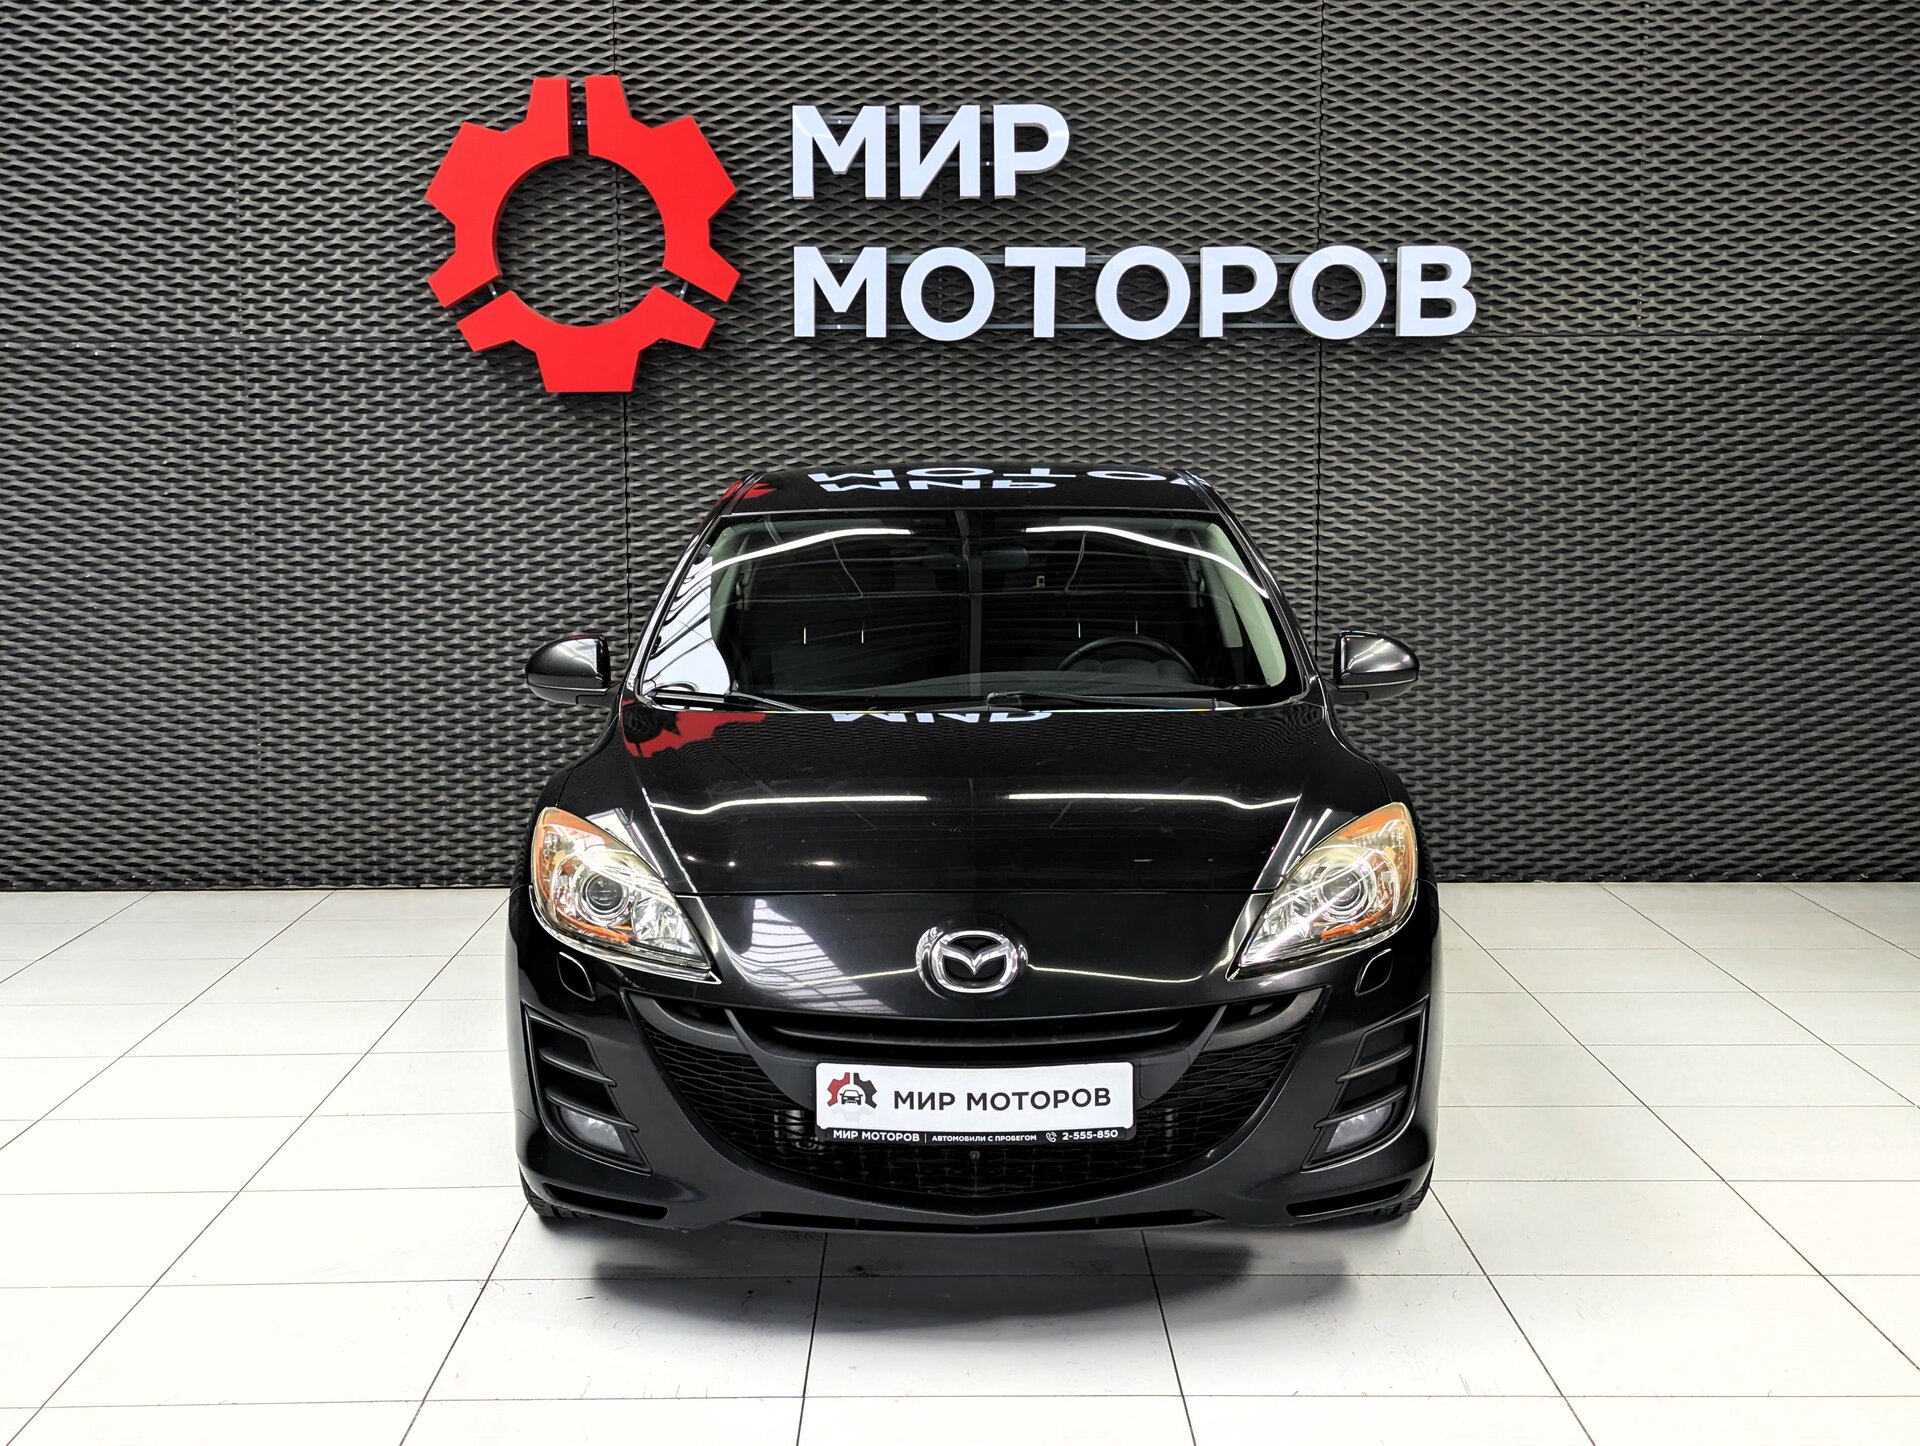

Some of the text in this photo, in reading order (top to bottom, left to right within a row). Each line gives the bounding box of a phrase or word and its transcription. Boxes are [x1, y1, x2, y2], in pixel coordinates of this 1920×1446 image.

[792, 104, 1070, 198] МИР
[793, 245, 1477, 340] МОТОРОВ
[894, 1088, 1111, 1111] МИР МОТОРОВ
[833, 1129, 920, 1142] МИР МОТОРОВ
[995, 1134, 1037, 1142] ПРОБЕГОМ
[1062, 1129, 1119, 1141] 2-555-850
